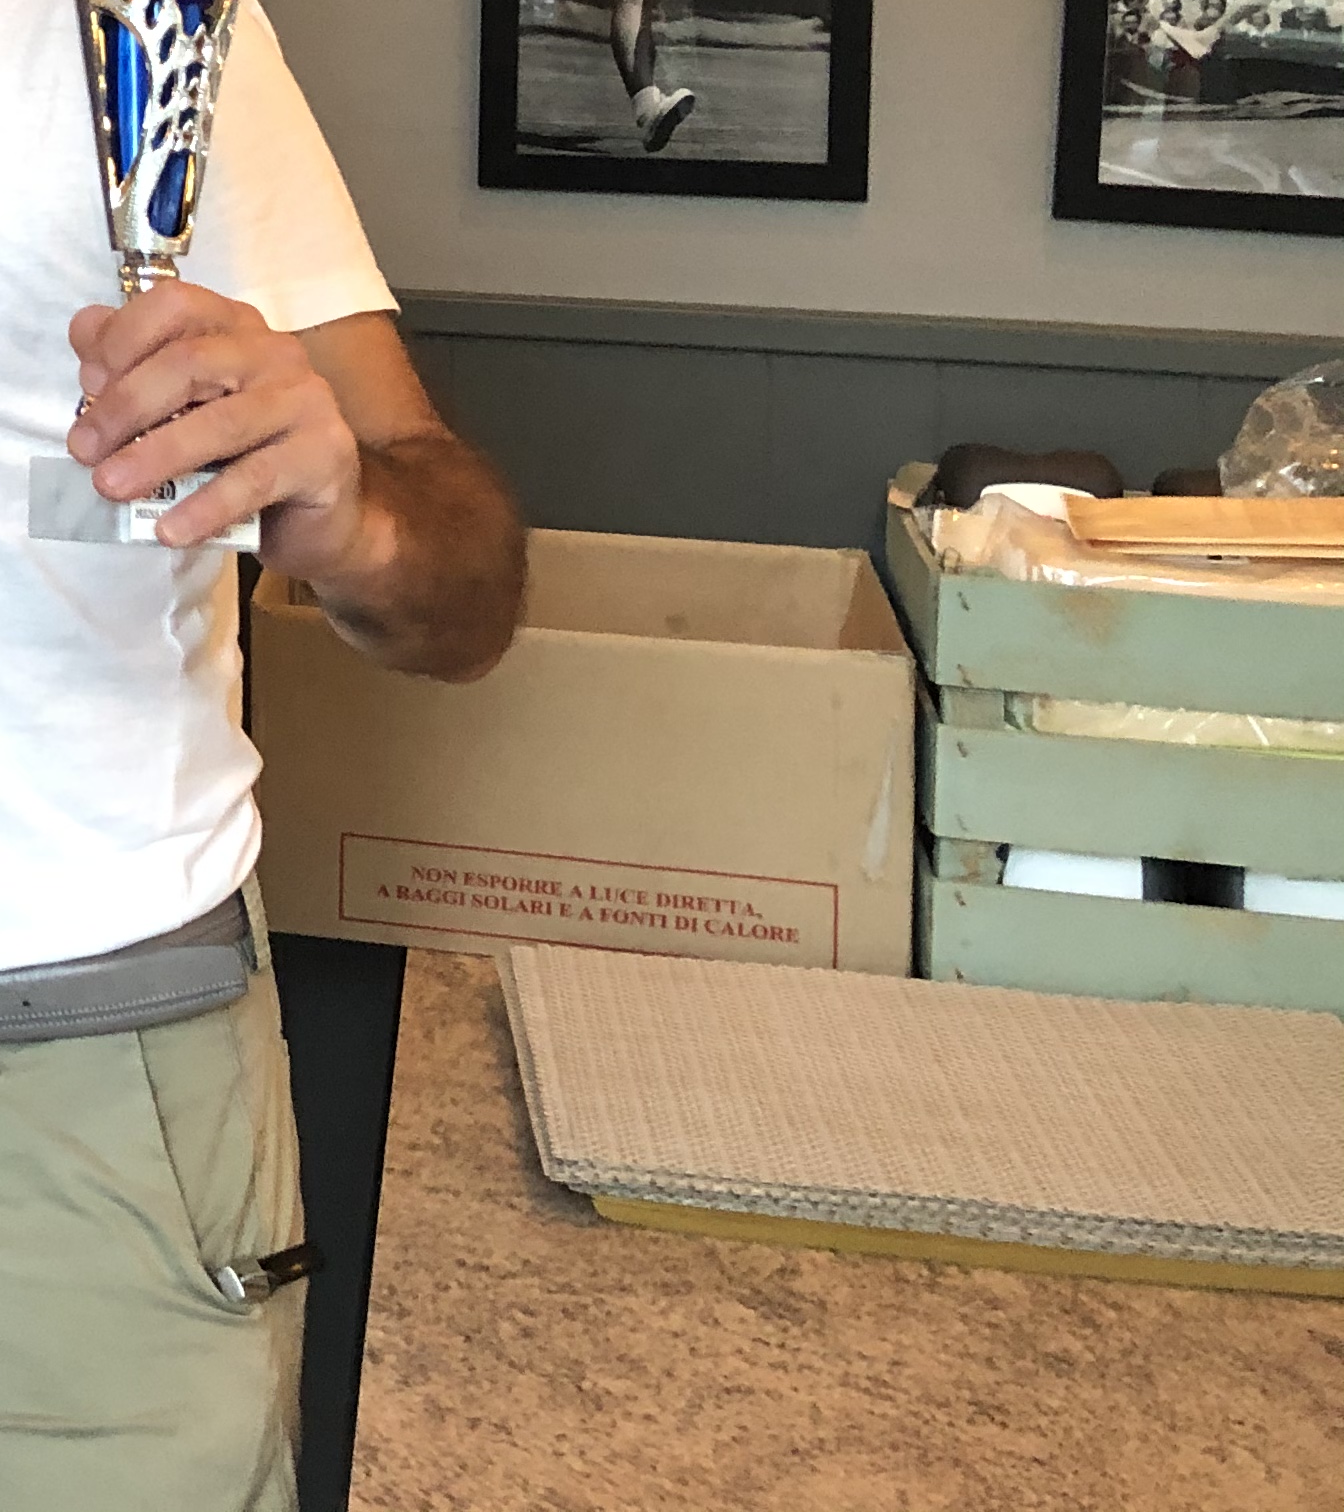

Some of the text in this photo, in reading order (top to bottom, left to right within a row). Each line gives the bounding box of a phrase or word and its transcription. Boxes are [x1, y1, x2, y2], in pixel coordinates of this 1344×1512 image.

[411, 866, 457, 884] NON
[462, 871, 562, 896] ESPORRE
[570, 884, 583, 900] A
[589, 885, 649, 906] LUCE
[377, 884, 390, 899] A
[470, 893, 552, 916] SOLARI
[559, 902, 573, 918] E
[579, 905, 594, 922] A
[599, 907, 667, 930] FONTI
[674, 915, 698, 934] DI
[703, 918, 801, 945] CALORE
